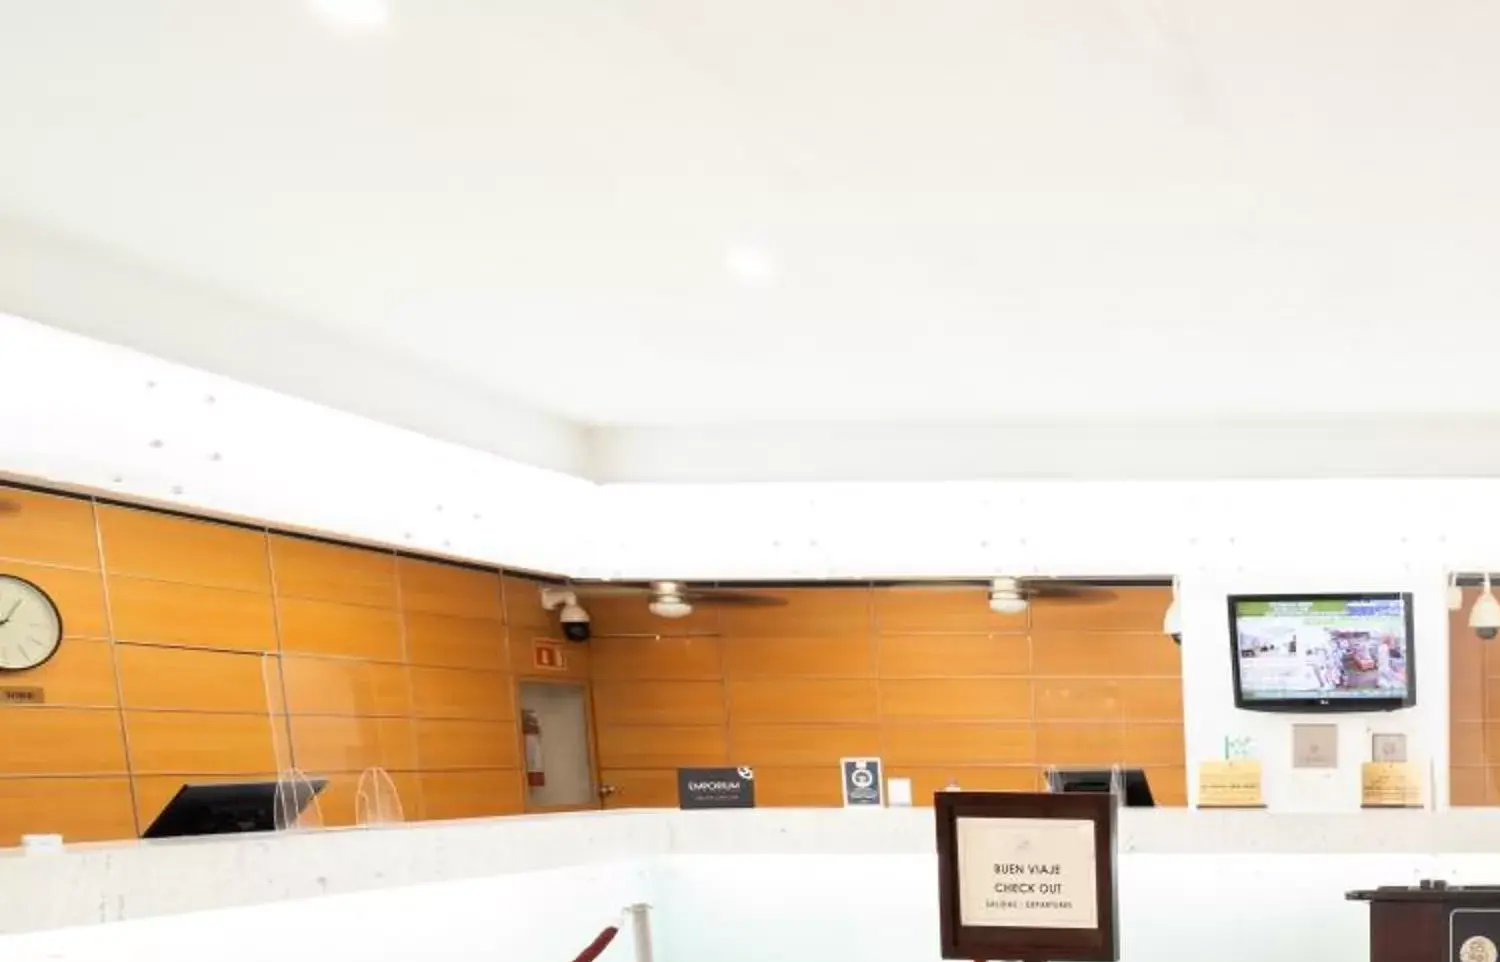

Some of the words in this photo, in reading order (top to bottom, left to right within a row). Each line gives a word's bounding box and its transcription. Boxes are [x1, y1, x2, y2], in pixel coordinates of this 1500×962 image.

[993, 863, 1024, 875] BUEN
[1027, 863, 1061, 875] VIAJE
[994, 883, 1035, 894] CHECK
[1039, 883, 1061, 895] OUT
